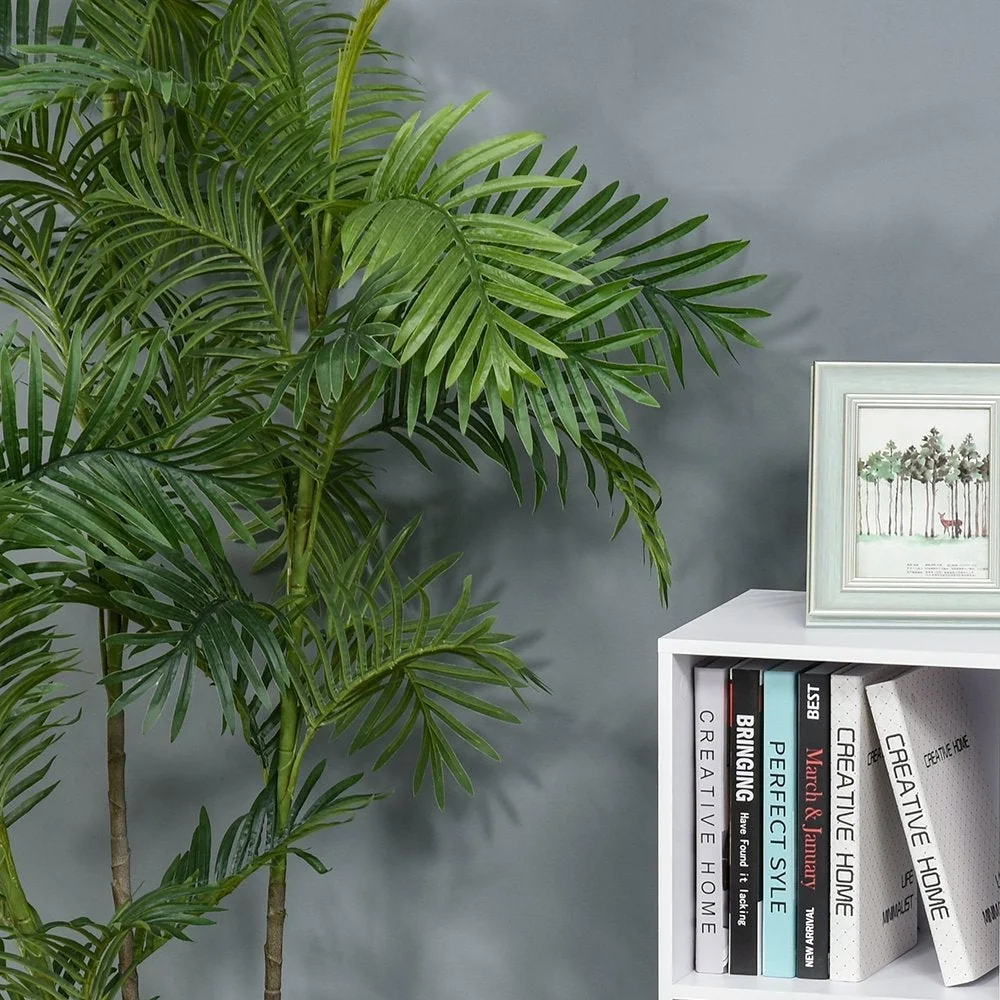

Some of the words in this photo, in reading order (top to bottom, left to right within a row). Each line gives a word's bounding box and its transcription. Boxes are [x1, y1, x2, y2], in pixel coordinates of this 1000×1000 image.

[806, 682, 821, 721] BEST
[699, 709, 716, 844] CREATIVE
[735, 713, 755, 803] BRINGING
[804, 747, 824, 803] March
[835, 726, 856, 842] CREATIVE
[738, 811, 750, 836] Have
[769, 740, 787, 850] PERFECT
[803, 806, 824, 822] &
[738, 838, 750, 868] Found
[884, 732, 933, 849] CREATIVE
[916, 855, 951, 922] HOME
[738, 872, 750, 884] it
[769, 856, 787, 914] SYLE
[800, 822, 823, 891] January
[834, 852, 855, 918] HOME
[700, 861, 717, 934] HOME
[736, 888, 750, 927] lacking
[804, 906, 816, 946] ARRIVAL
[804, 946, 816, 969] NEW
